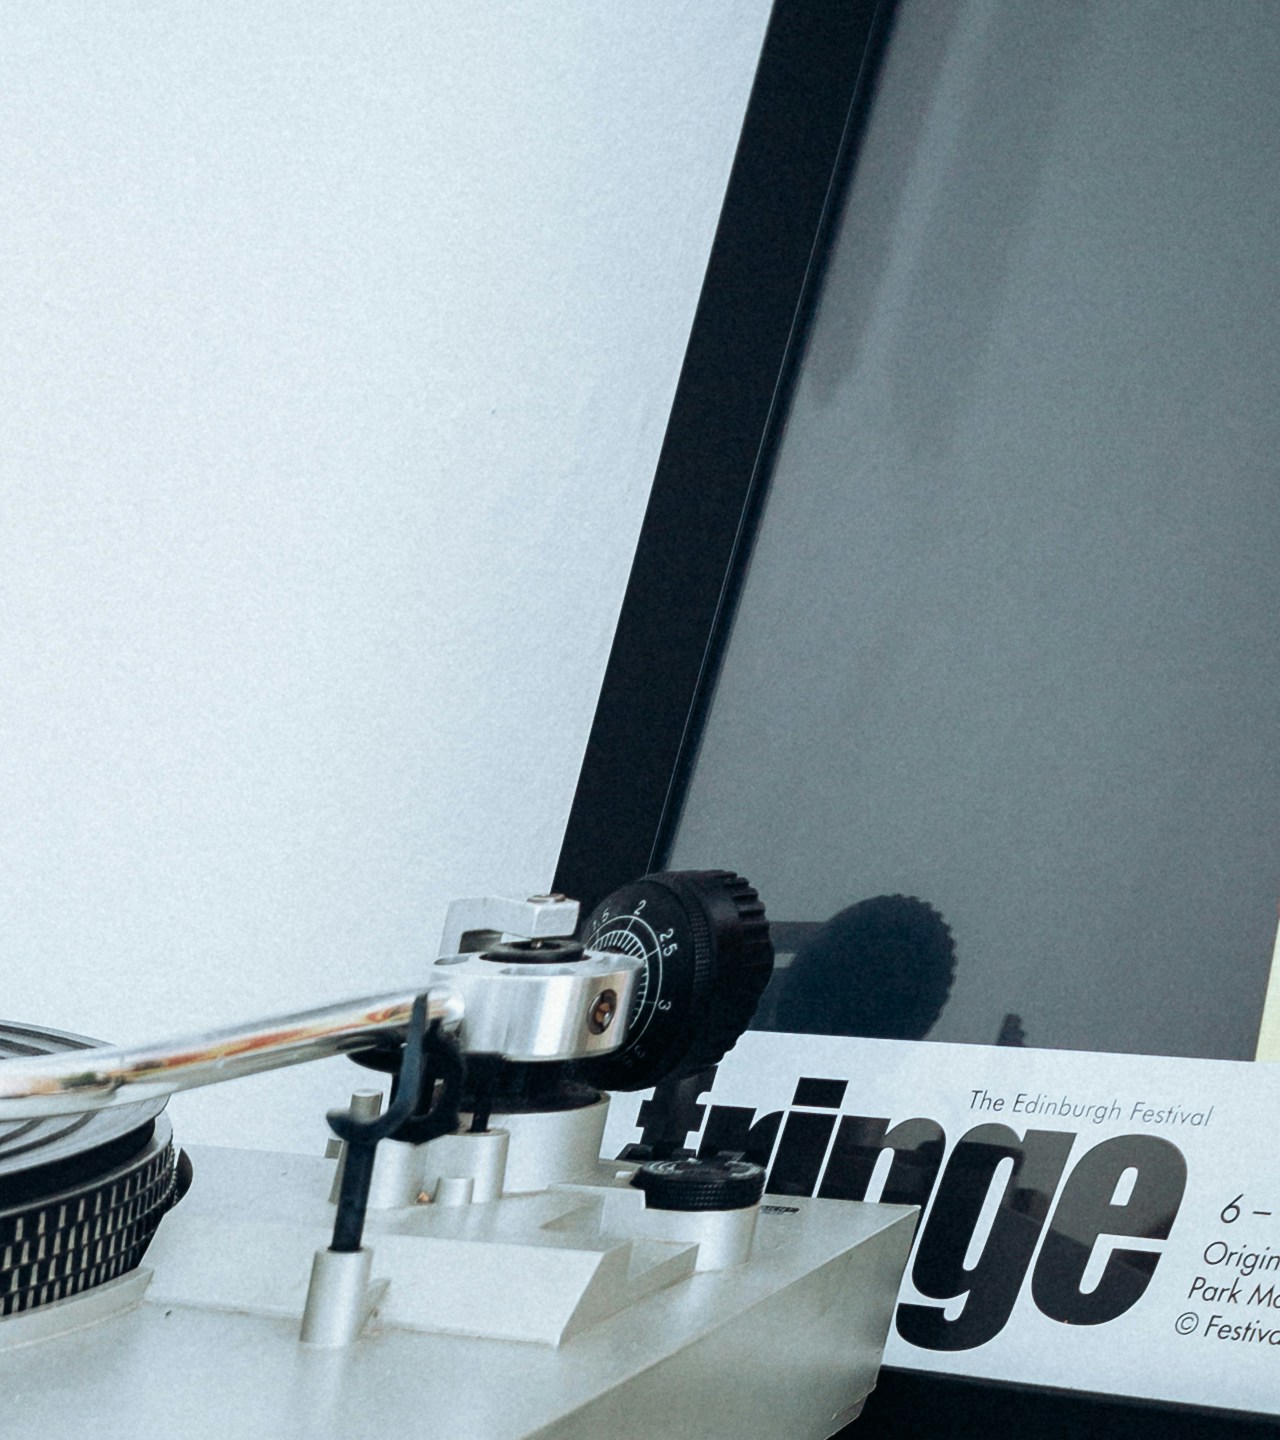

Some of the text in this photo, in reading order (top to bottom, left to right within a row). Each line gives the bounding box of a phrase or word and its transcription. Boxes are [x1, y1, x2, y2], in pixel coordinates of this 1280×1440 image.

[633, 899, 647, 917] 2
[658, 927, 678, 957] 2.5
[657, 1000, 672, 1012] 3
[971, 1089, 1215, 1127] The Edinburgh Festival
[1220, 1193, 1244, 1224] 6
[1187, 1276, 1243, 1306] Park
